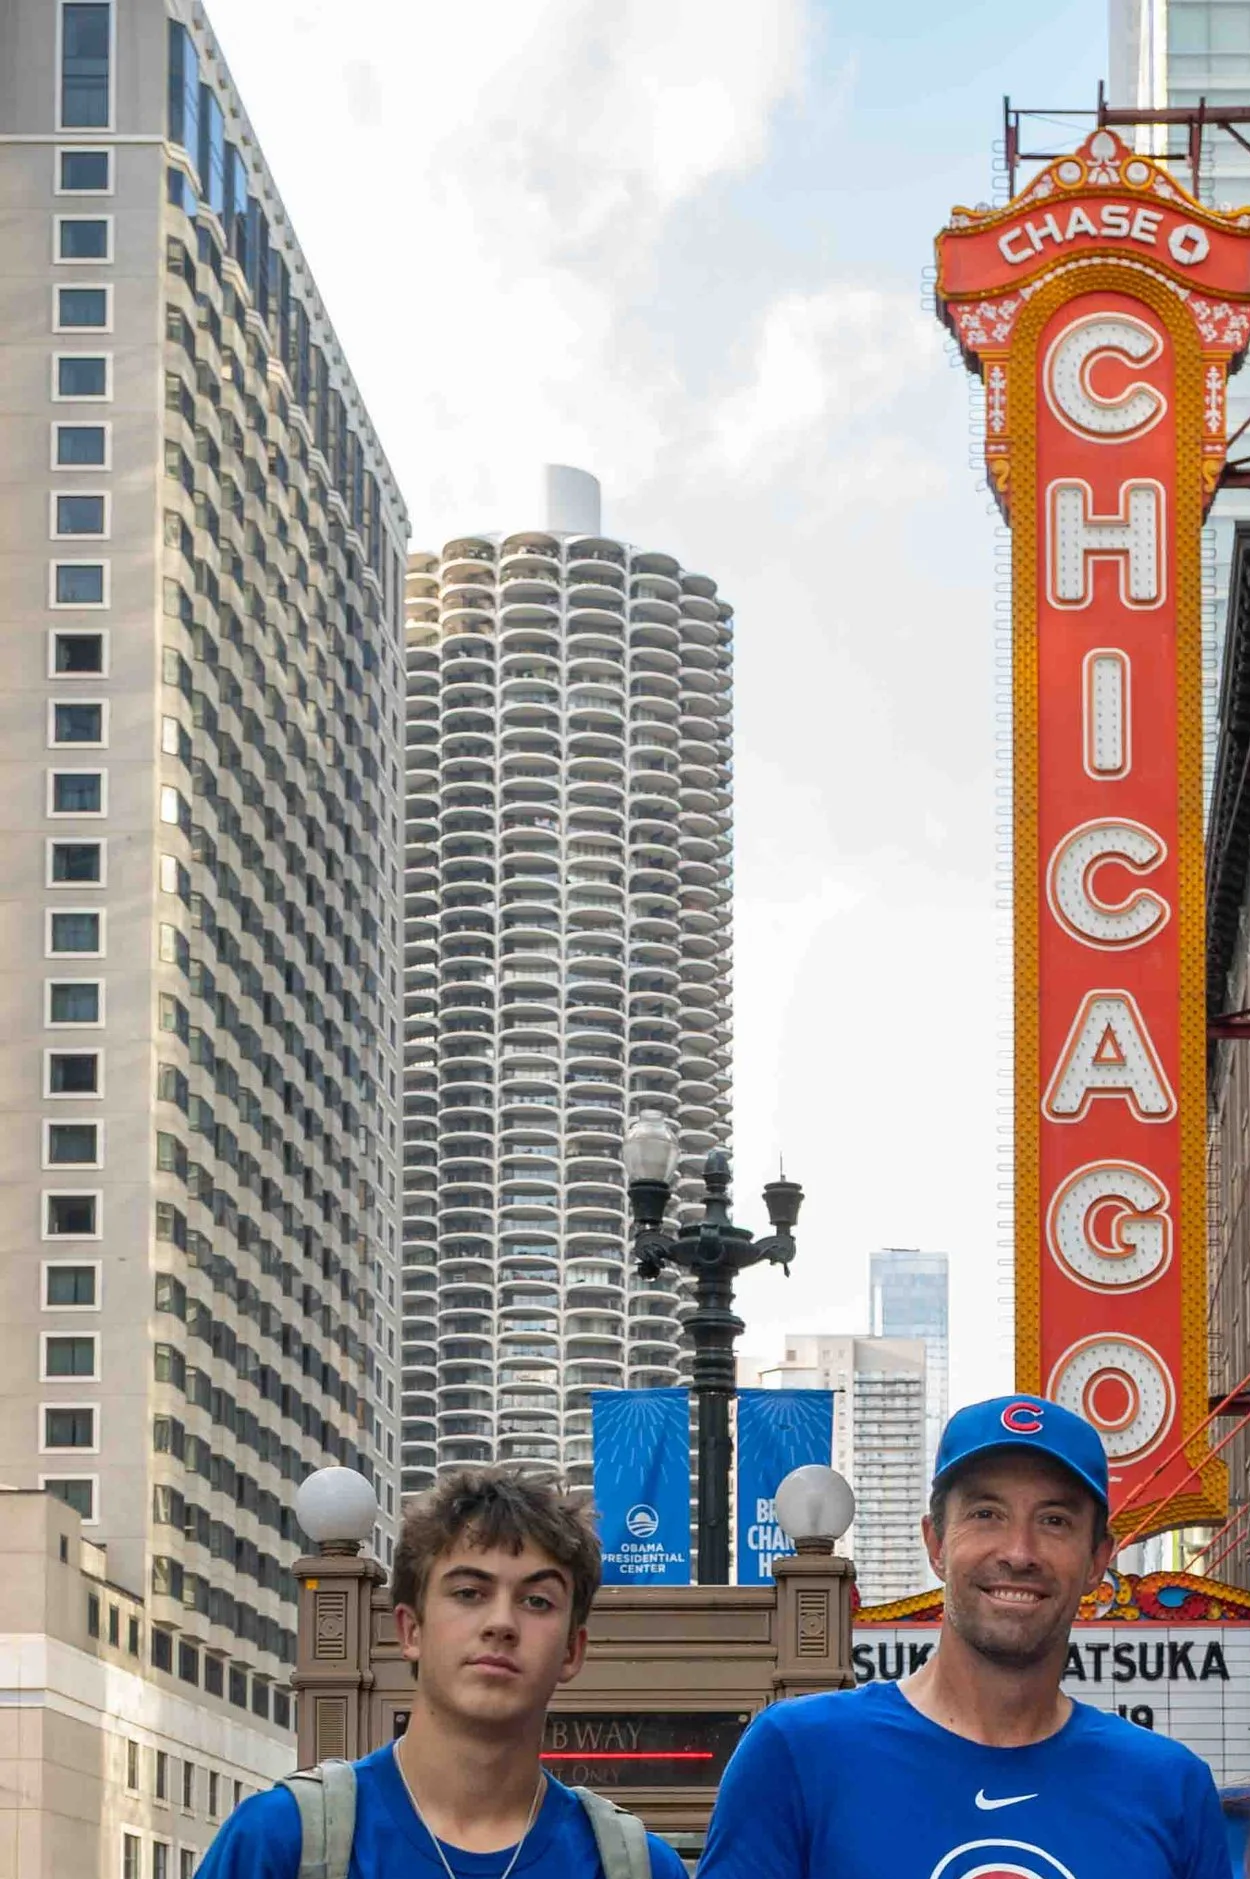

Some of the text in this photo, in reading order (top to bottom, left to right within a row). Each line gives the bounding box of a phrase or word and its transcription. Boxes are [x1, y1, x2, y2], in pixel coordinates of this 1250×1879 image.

[998, 204, 1164, 265] CHASE
[1042, 311, 1178, 1468] CHICAGO
[1001, 1402, 1044, 1434] C
[601, 1553, 685, 1564] PRESIDENTIAL
[620, 1543, 664, 1553] OBAMA
[619, 1564, 666, 1574] CENTER
